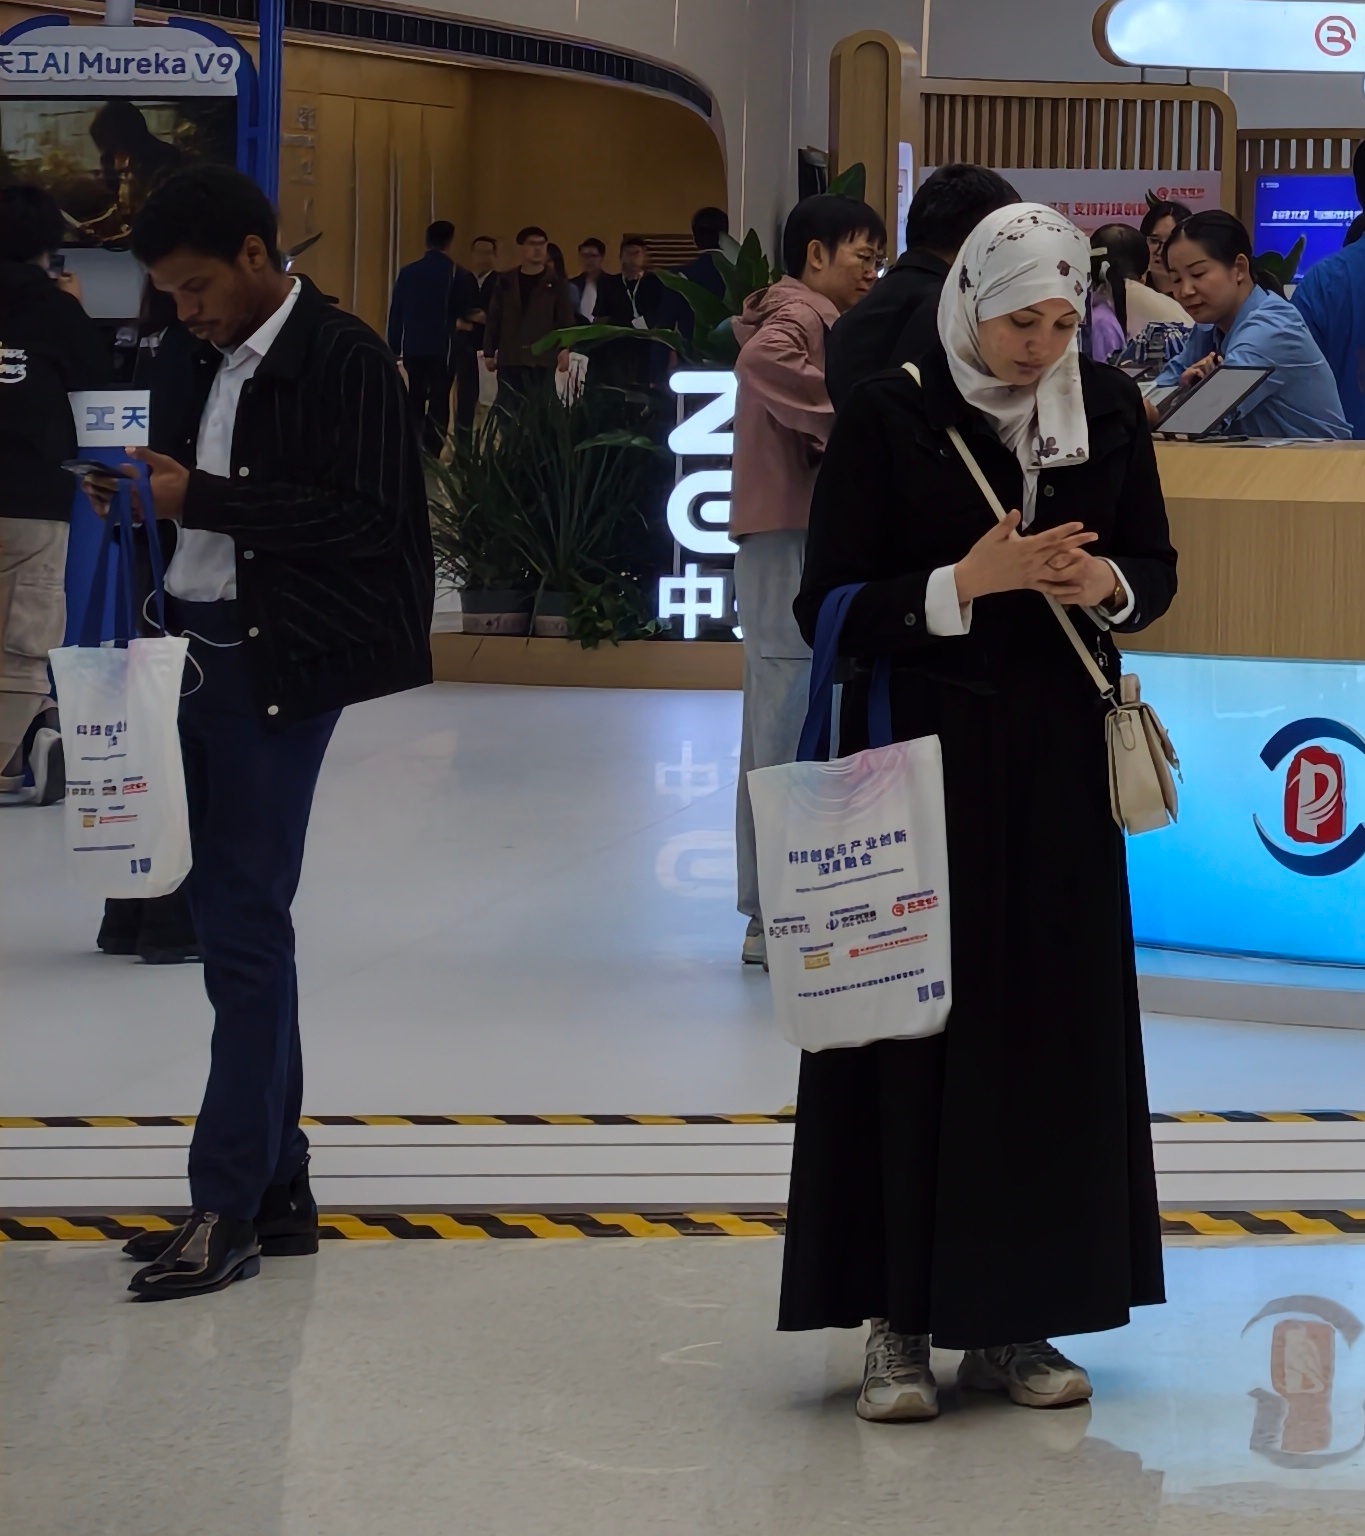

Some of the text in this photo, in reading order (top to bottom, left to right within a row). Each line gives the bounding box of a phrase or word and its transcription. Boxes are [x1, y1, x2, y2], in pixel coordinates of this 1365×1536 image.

[79, 51, 186, 75] Mureka
[194, 52, 234, 74] V9
[658, 563, 745, 640] 中
